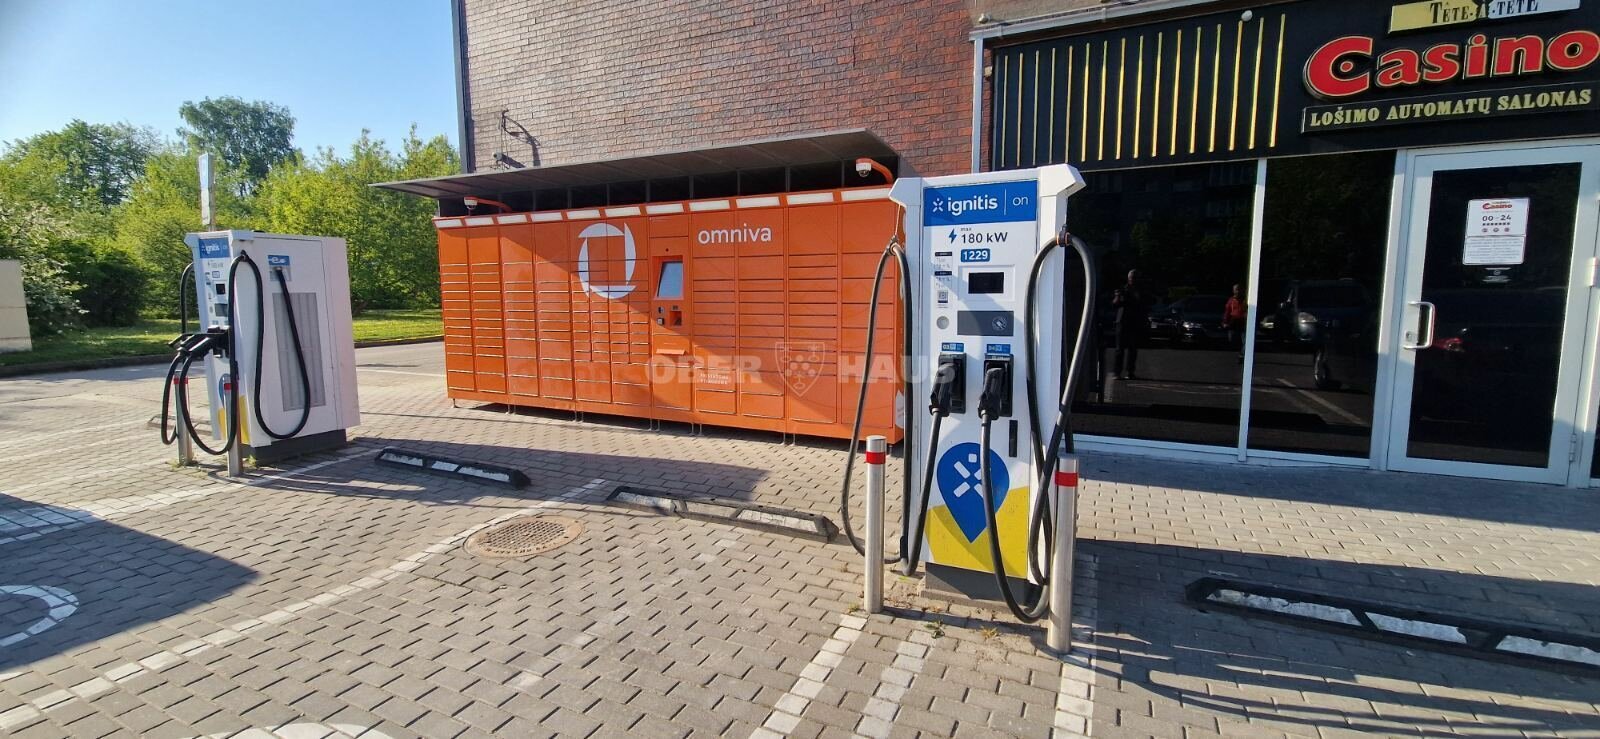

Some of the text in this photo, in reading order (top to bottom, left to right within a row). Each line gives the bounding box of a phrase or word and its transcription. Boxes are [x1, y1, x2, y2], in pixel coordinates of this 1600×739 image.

[1304, 30, 1600, 97] Casino
[1310, 89, 1592, 126] LOŠIMO AUTOMATŲ SALONAS
[947, 194, 1029, 216] ignitis on
[697, 222, 773, 246] omniva
[961, 231, 1008, 244] 180 kW
[963, 250, 988, 260] 1229
